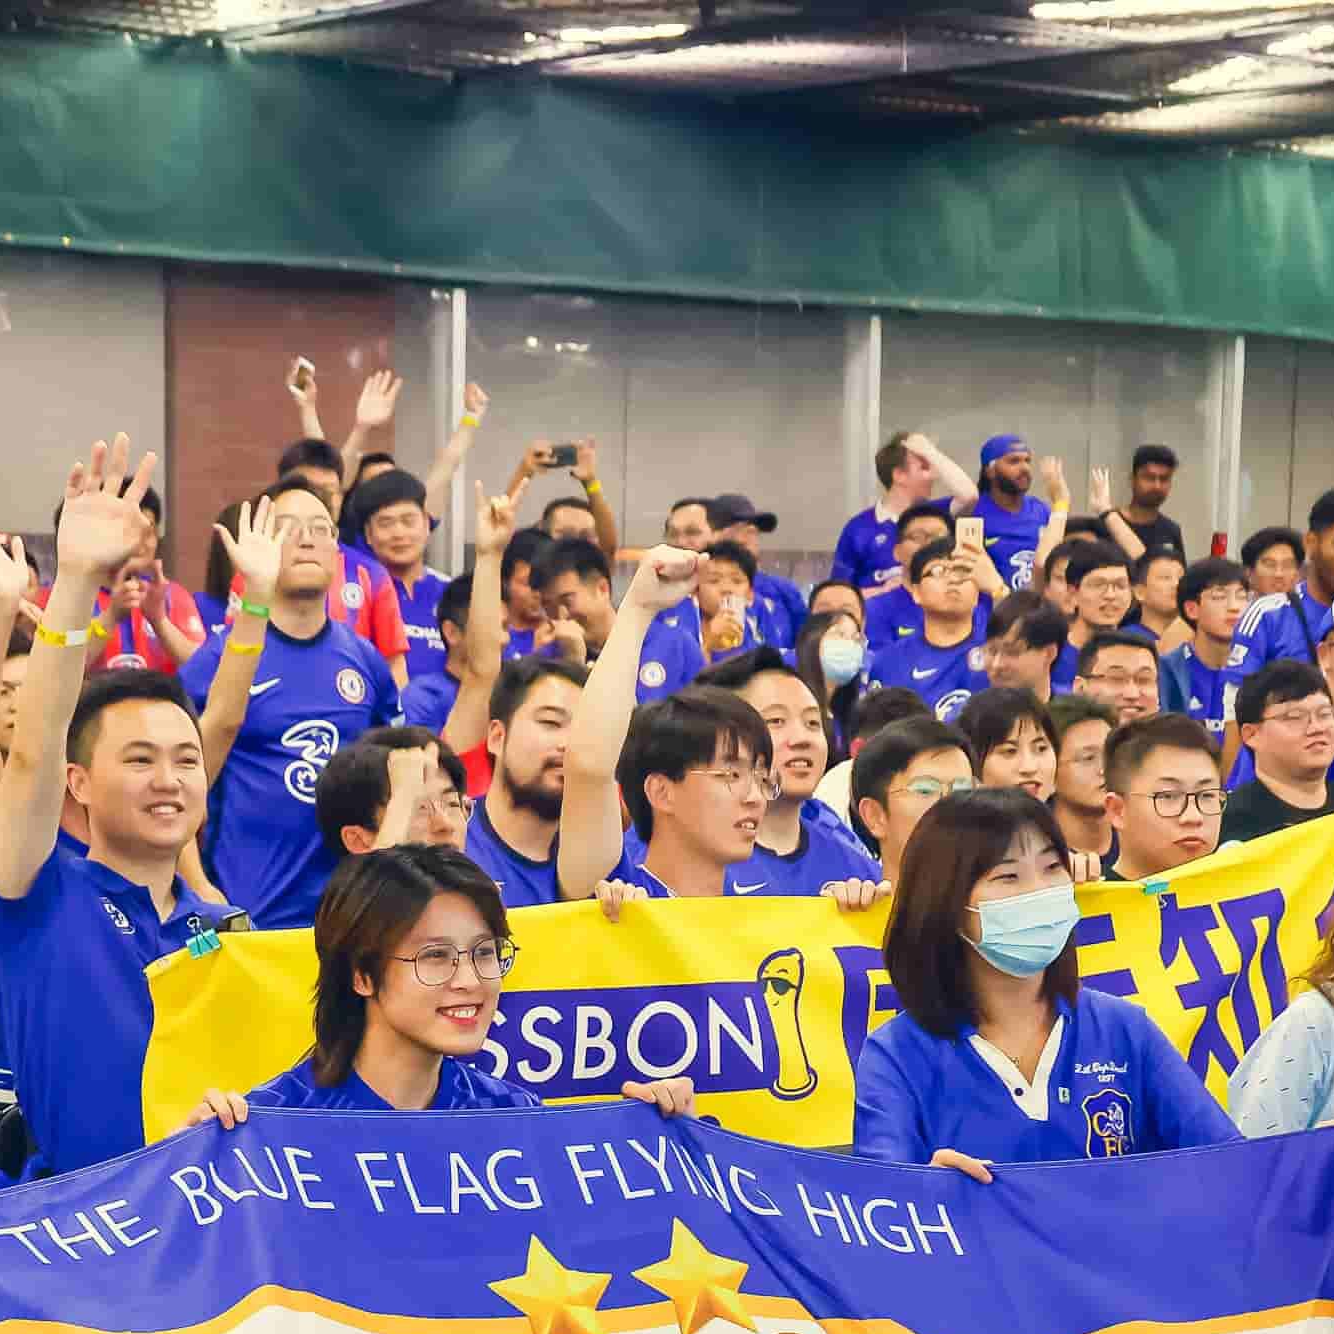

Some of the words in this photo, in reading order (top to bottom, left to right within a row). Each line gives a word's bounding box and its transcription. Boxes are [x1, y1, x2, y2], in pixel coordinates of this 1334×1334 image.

[170, 1146, 335, 1226] BLUE
[355, 1148, 543, 1215] FLAG
[563, 1135, 782, 1216] FLYING
[796, 1183, 965, 1257] HIGH
